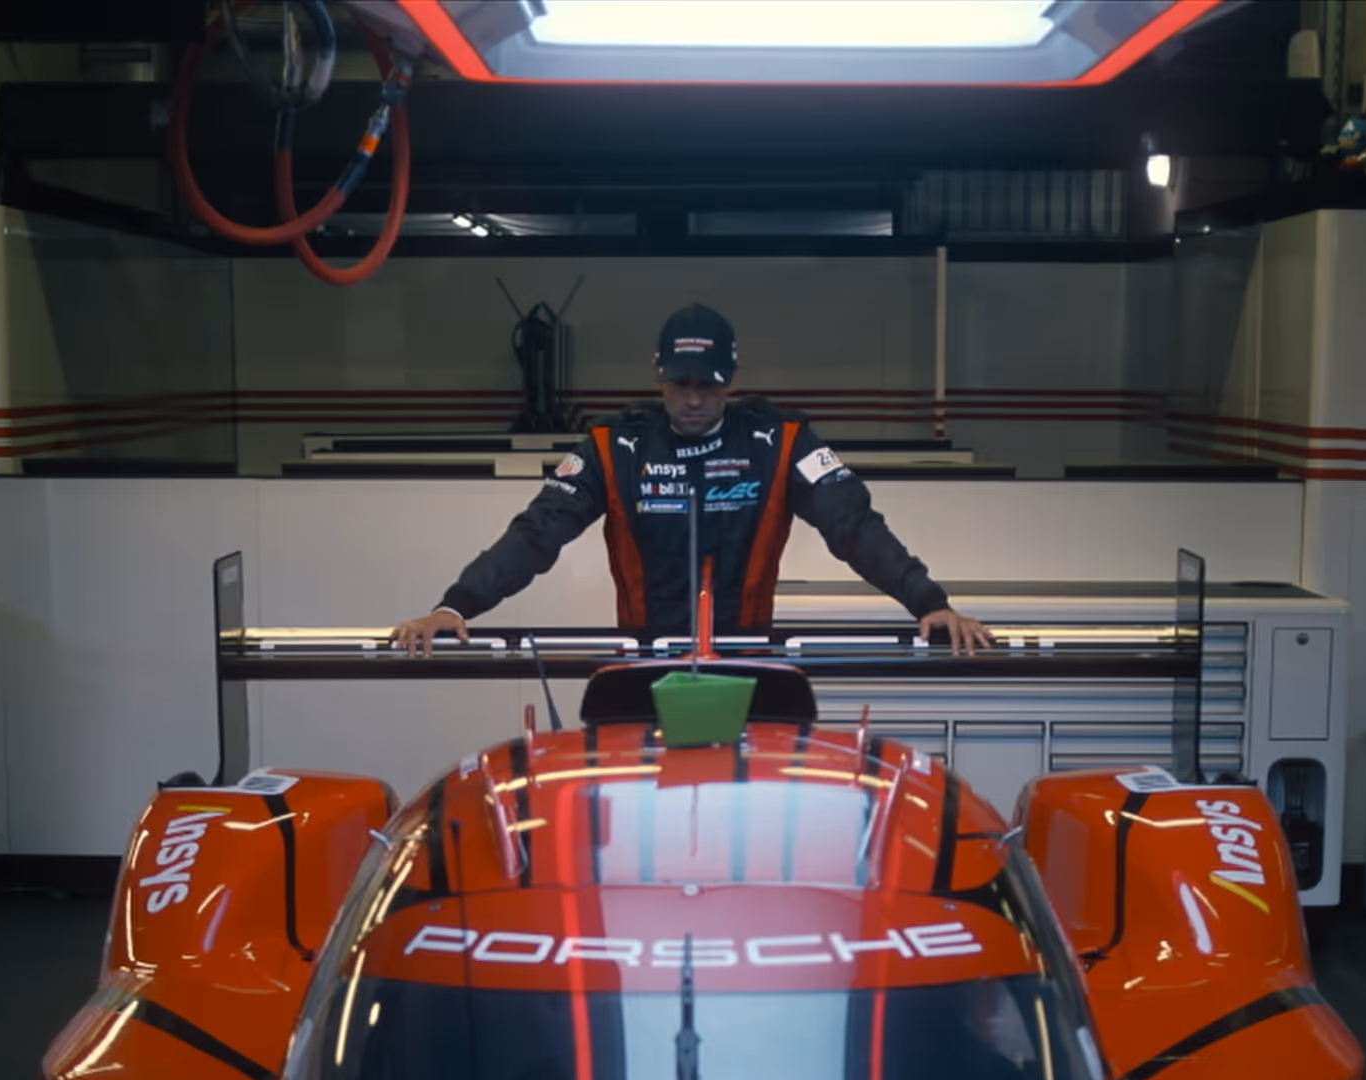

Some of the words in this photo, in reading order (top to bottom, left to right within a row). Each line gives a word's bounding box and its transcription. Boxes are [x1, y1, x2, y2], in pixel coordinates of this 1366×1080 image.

[642, 462, 687, 478] Ansys
[139, 804, 233, 914] Ansys
[1196, 799, 1271, 914] Ansys
[403, 921, 983, 968] PORSCHE
